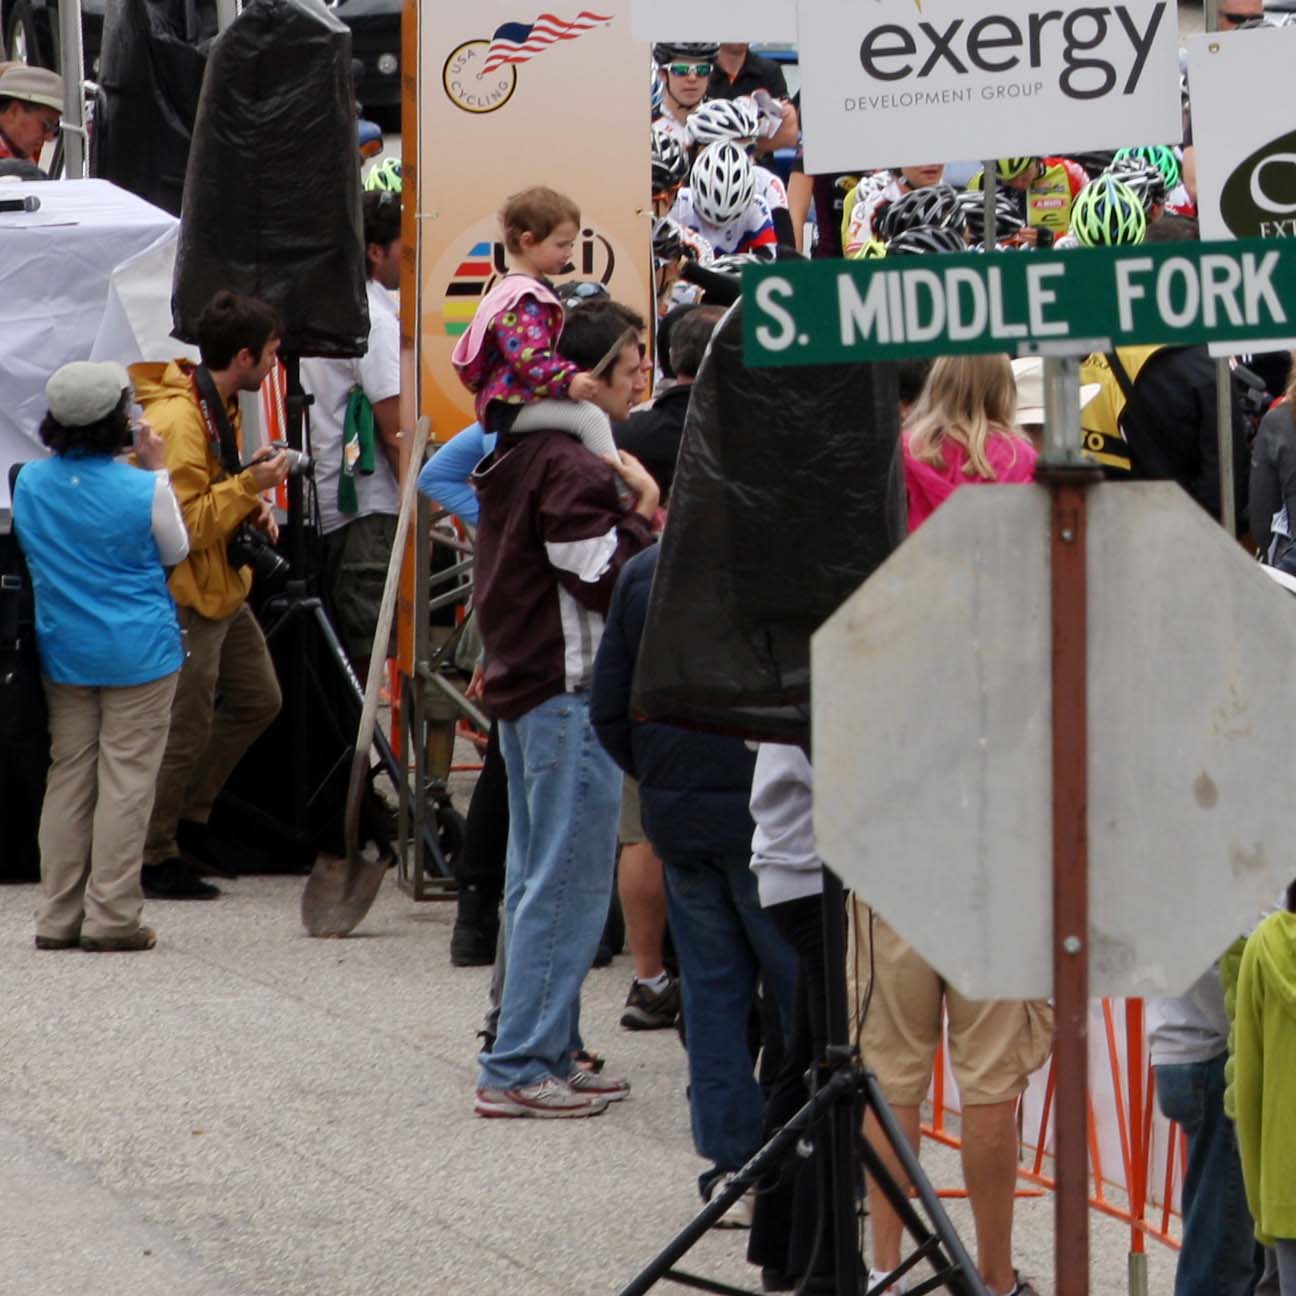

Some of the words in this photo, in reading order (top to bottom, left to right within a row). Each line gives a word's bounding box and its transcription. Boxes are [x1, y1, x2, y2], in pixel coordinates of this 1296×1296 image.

[451, 48, 477, 75] USA
[858, 0, 1167, 101] exergy
[450, 80, 509, 107] CYCLING
[843, 87, 974, 112] DEVELOPMENT
[980, 81, 1045, 103] GROUP
[755, 274, 811, 352] S.
[839, 261, 1070, 344] MIDDLE
[1115, 252, 1289, 333] FORK
